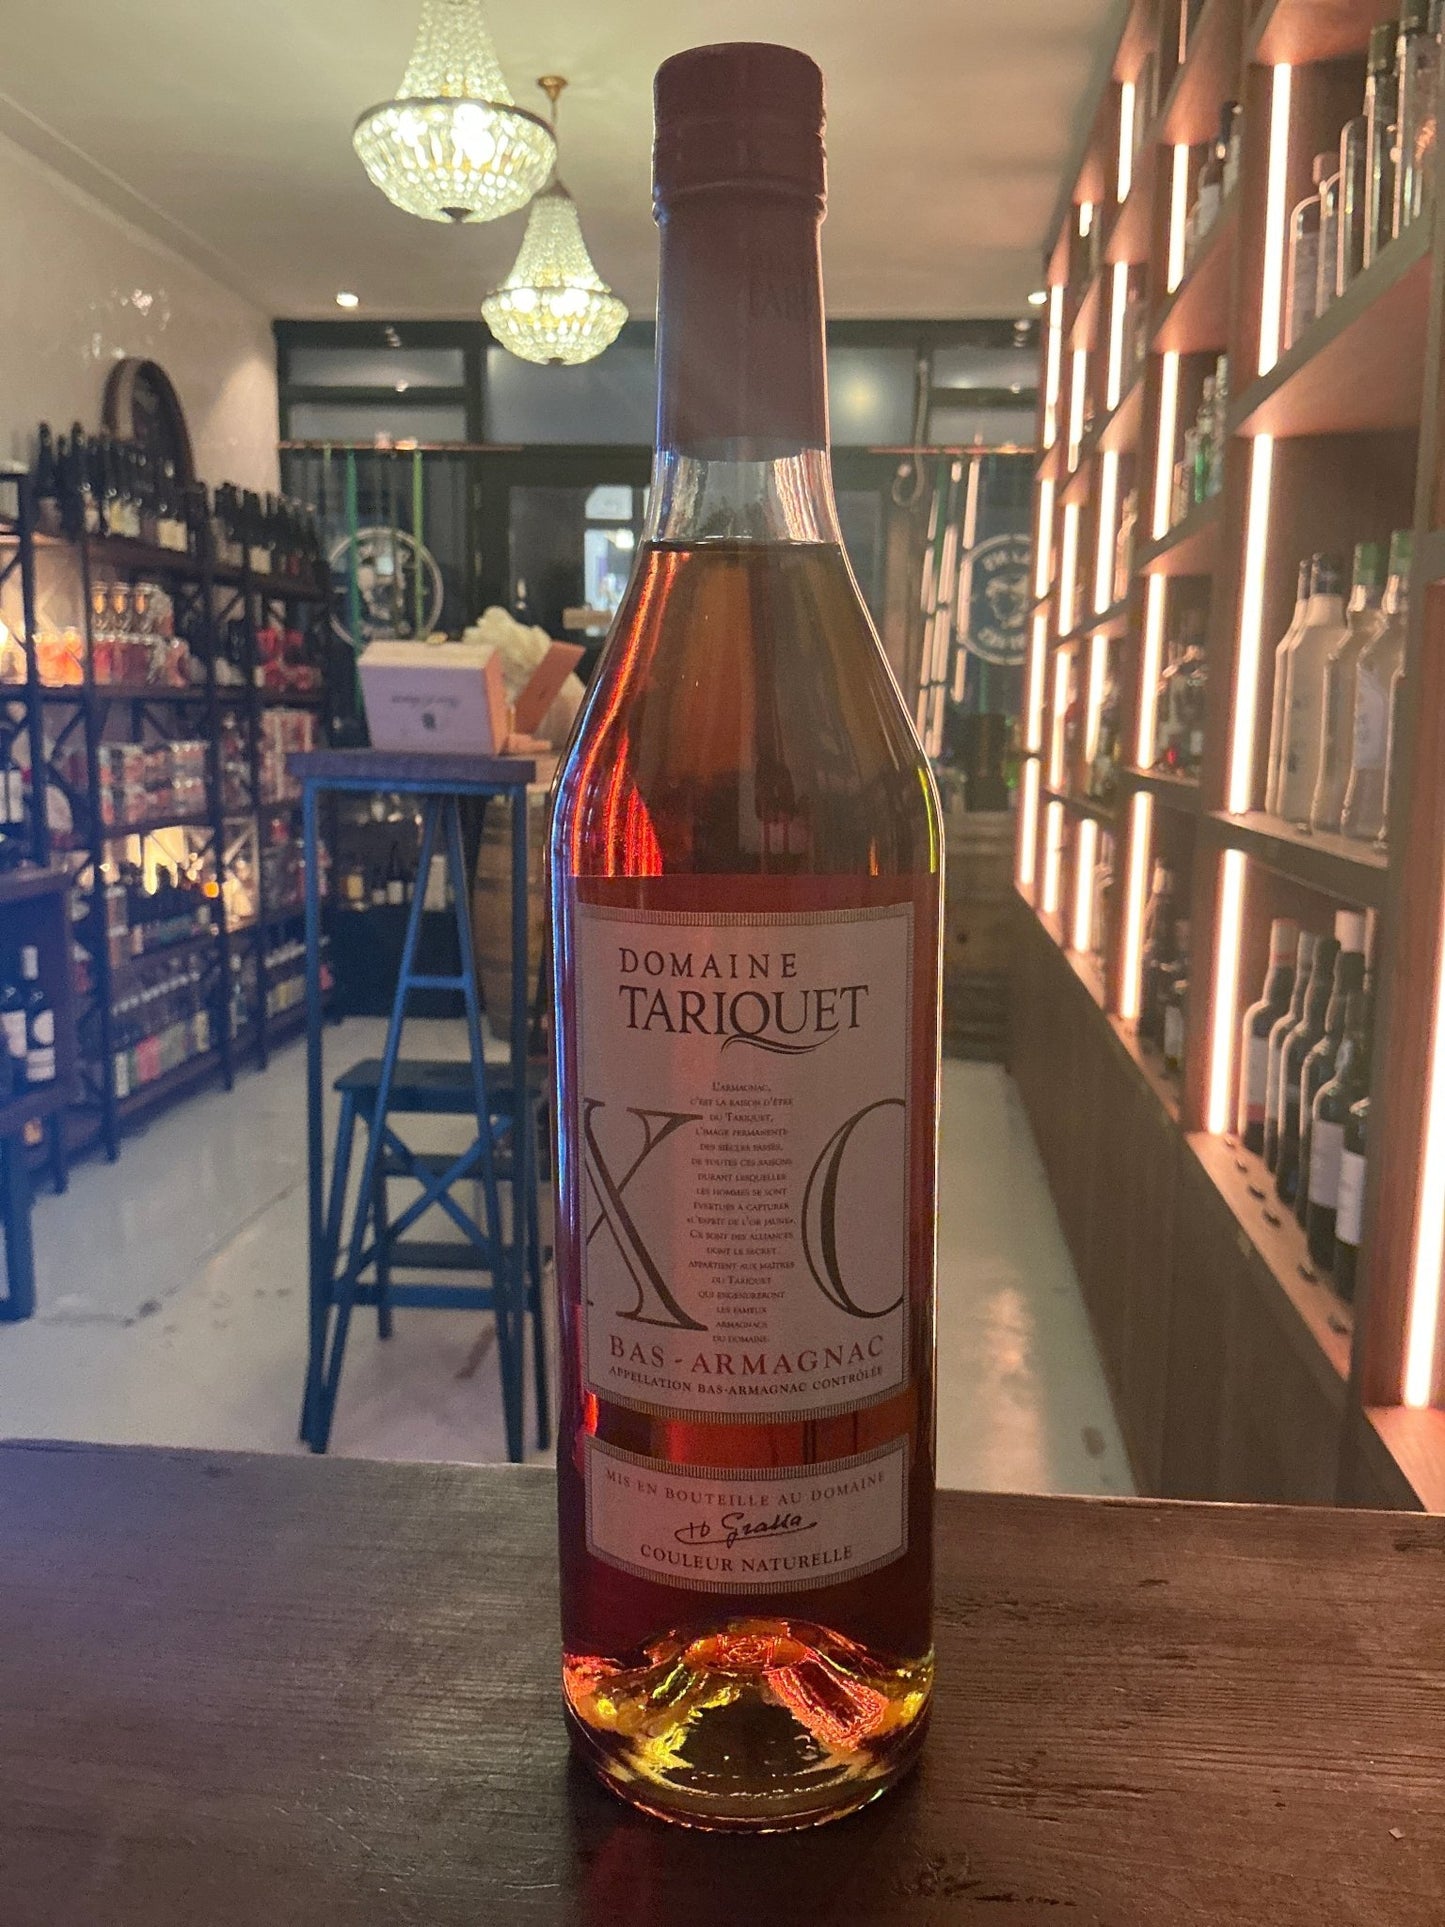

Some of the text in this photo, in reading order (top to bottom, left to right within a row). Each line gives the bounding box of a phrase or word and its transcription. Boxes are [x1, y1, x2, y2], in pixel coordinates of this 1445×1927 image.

[619, 947, 798, 979] DOMAINE
[618, 984, 870, 1055] TARIQUET
[610, 1334, 665, 1368] BAS
[691, 1335, 884, 1376] ARMAGNAC
[609, 1364, 883, 1395] APPELLATION BAS-ARMAGNAC CONTRÔLÉE
[605, 1469, 886, 1507] MIS EN BOUTEILLE AU DOMAINE
[640, 1544, 853, 1573] COULEUR NATURELLE
